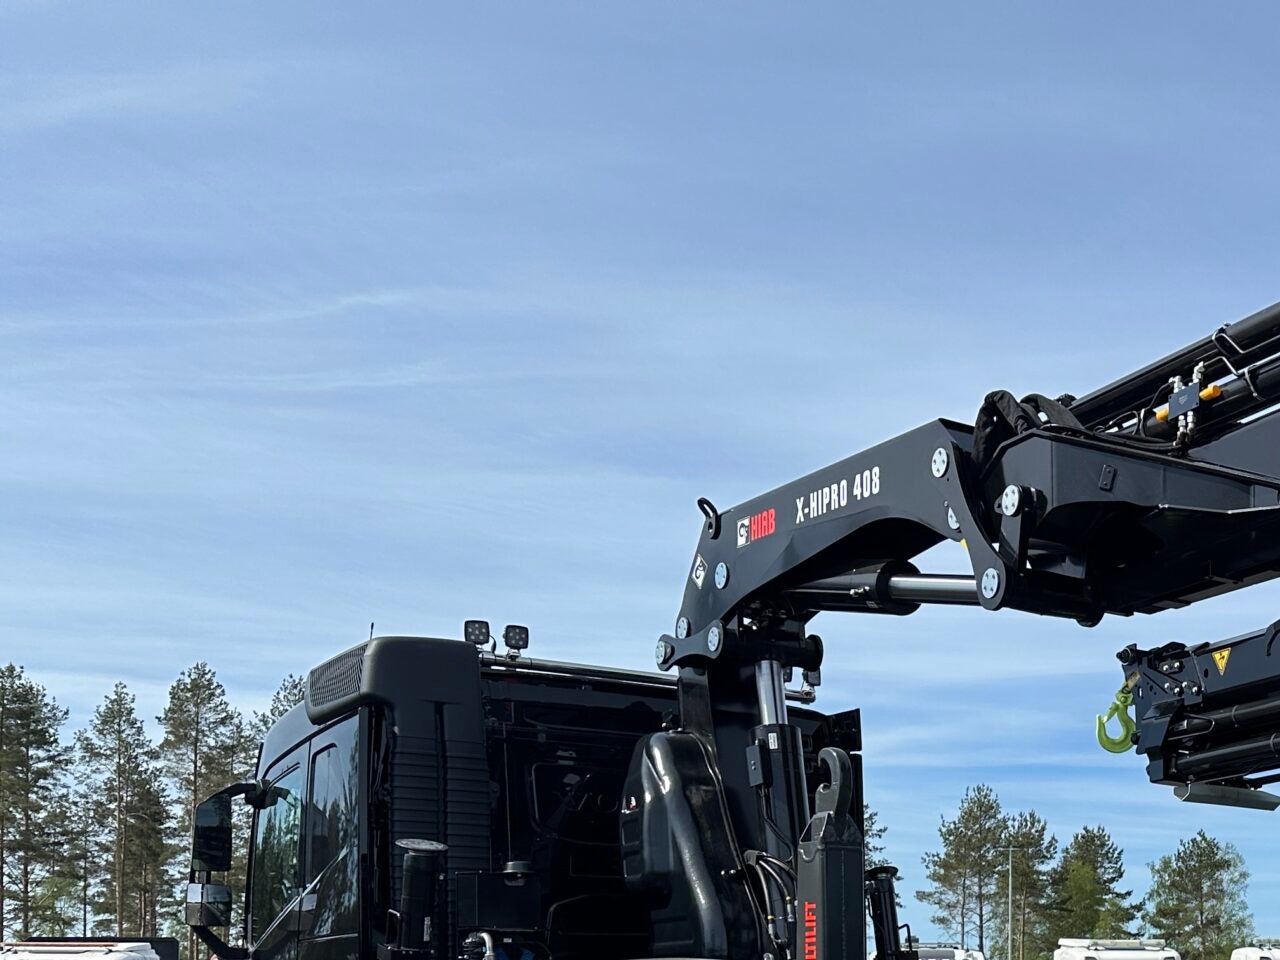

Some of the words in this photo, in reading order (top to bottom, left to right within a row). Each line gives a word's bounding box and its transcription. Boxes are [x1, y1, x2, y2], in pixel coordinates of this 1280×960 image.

[795, 479, 848, 525] X-HIPRO
[853, 466, 880, 501] 408
[750, 508, 776, 542] HIAB
